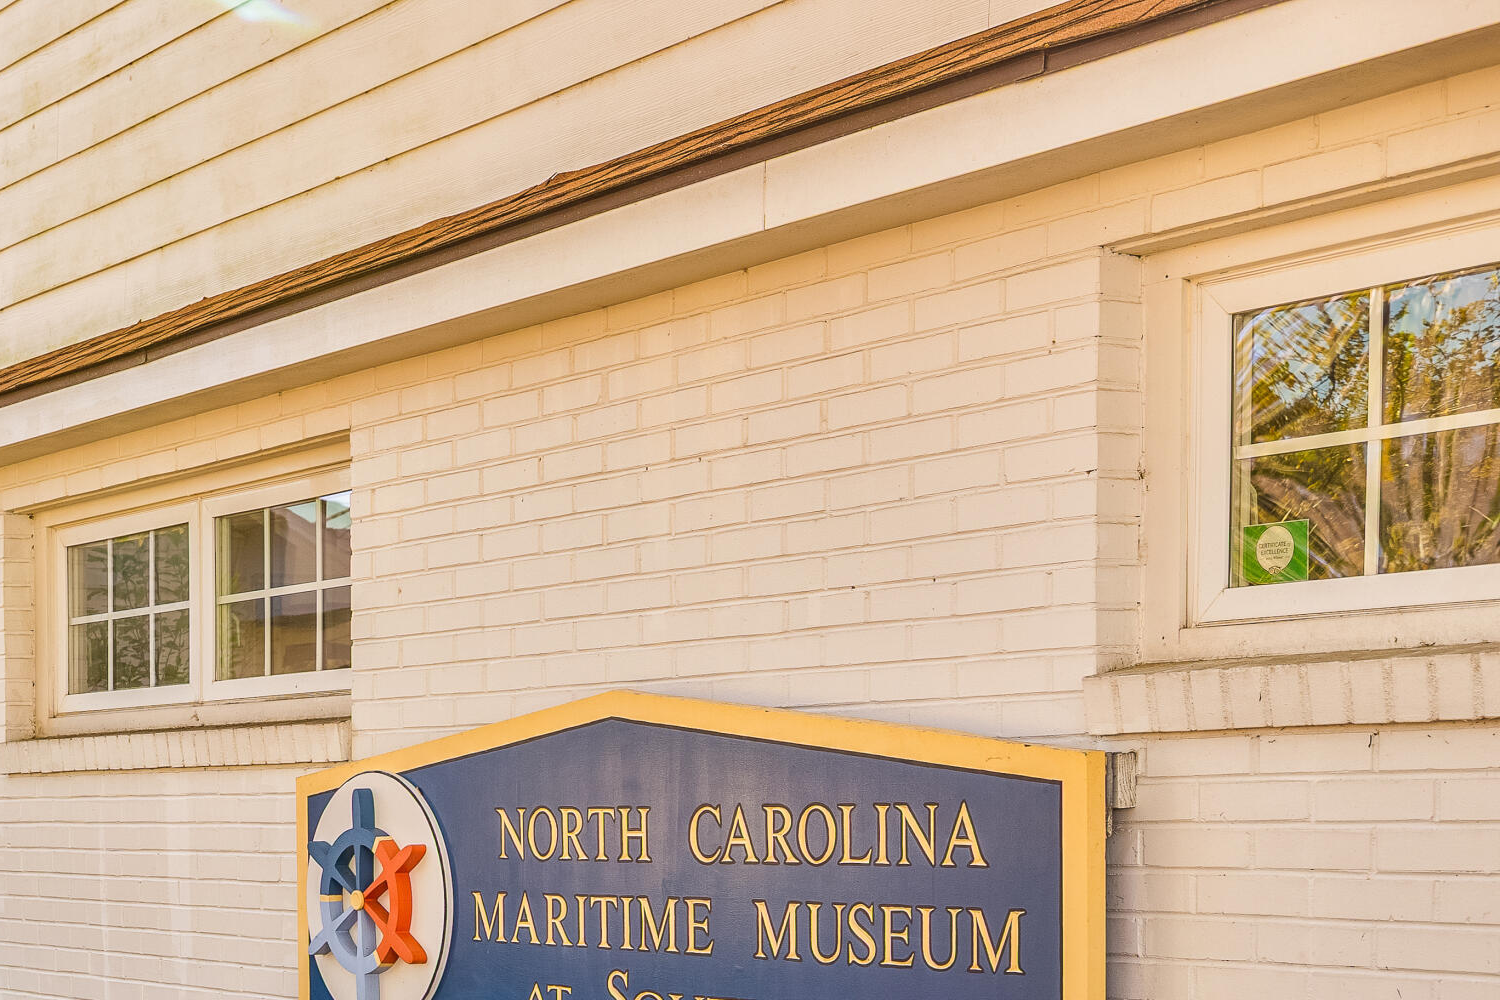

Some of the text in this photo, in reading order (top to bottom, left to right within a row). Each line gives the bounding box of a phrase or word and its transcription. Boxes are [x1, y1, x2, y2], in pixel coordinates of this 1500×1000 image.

[495, 800, 989, 868] NORTH CAROLINA
[471, 890, 1027, 976] MARITIME MUSEUM
